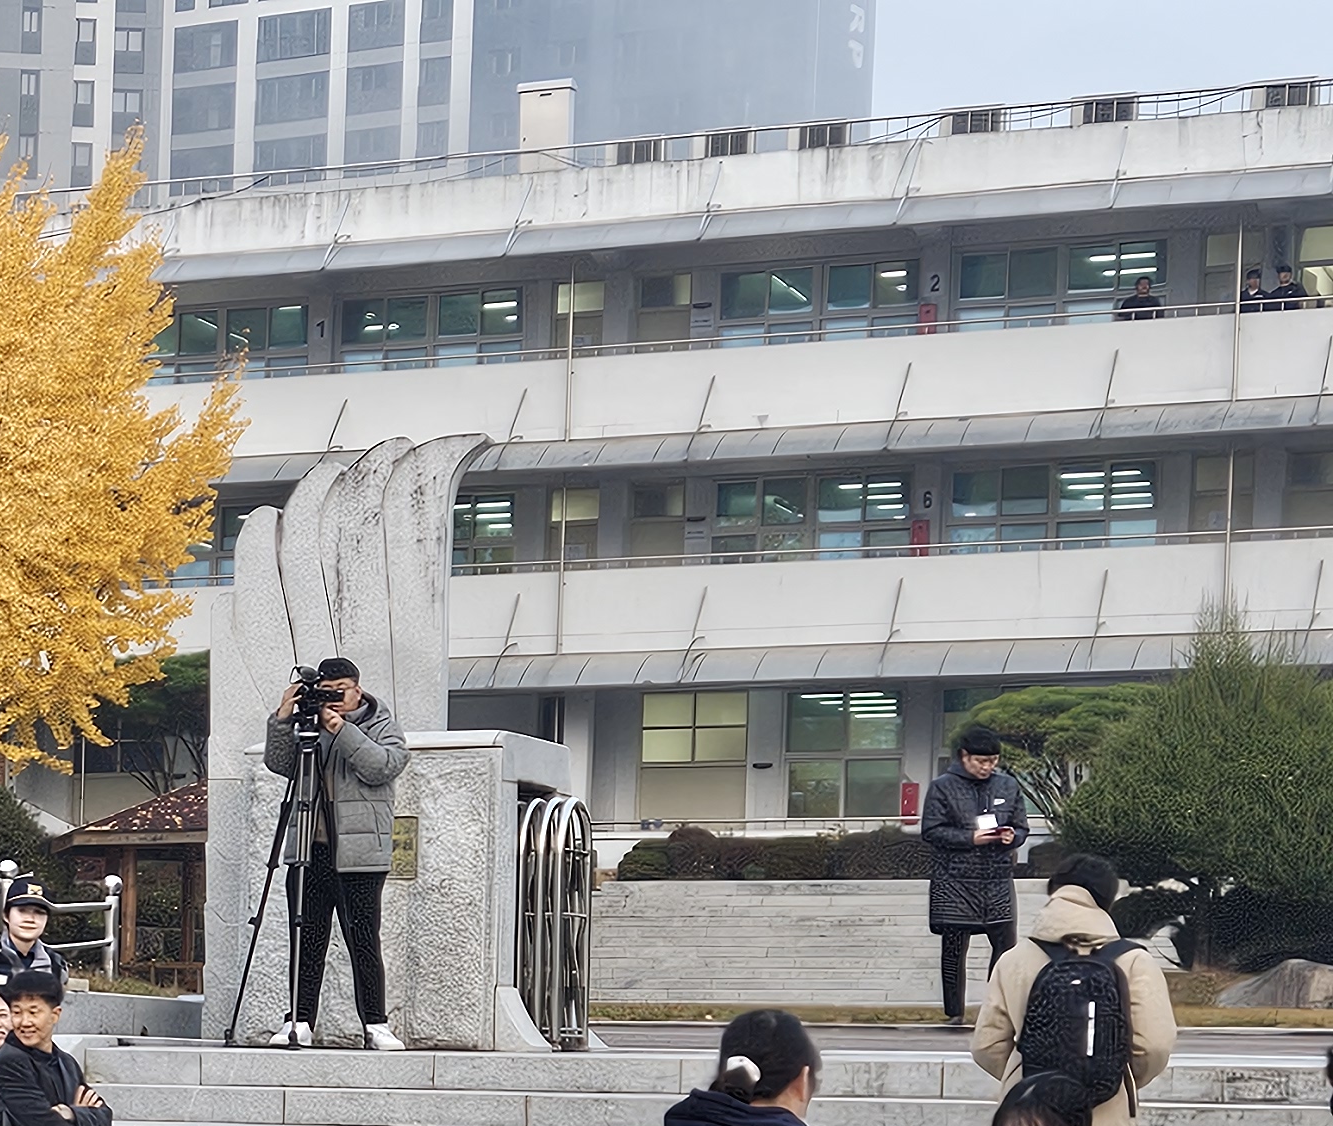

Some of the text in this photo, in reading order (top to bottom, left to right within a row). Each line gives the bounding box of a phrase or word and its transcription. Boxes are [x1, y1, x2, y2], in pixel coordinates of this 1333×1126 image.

[930, 274, 940, 292] 2
[316, 320, 325, 338] 1
[923, 490, 932, 509] 6
